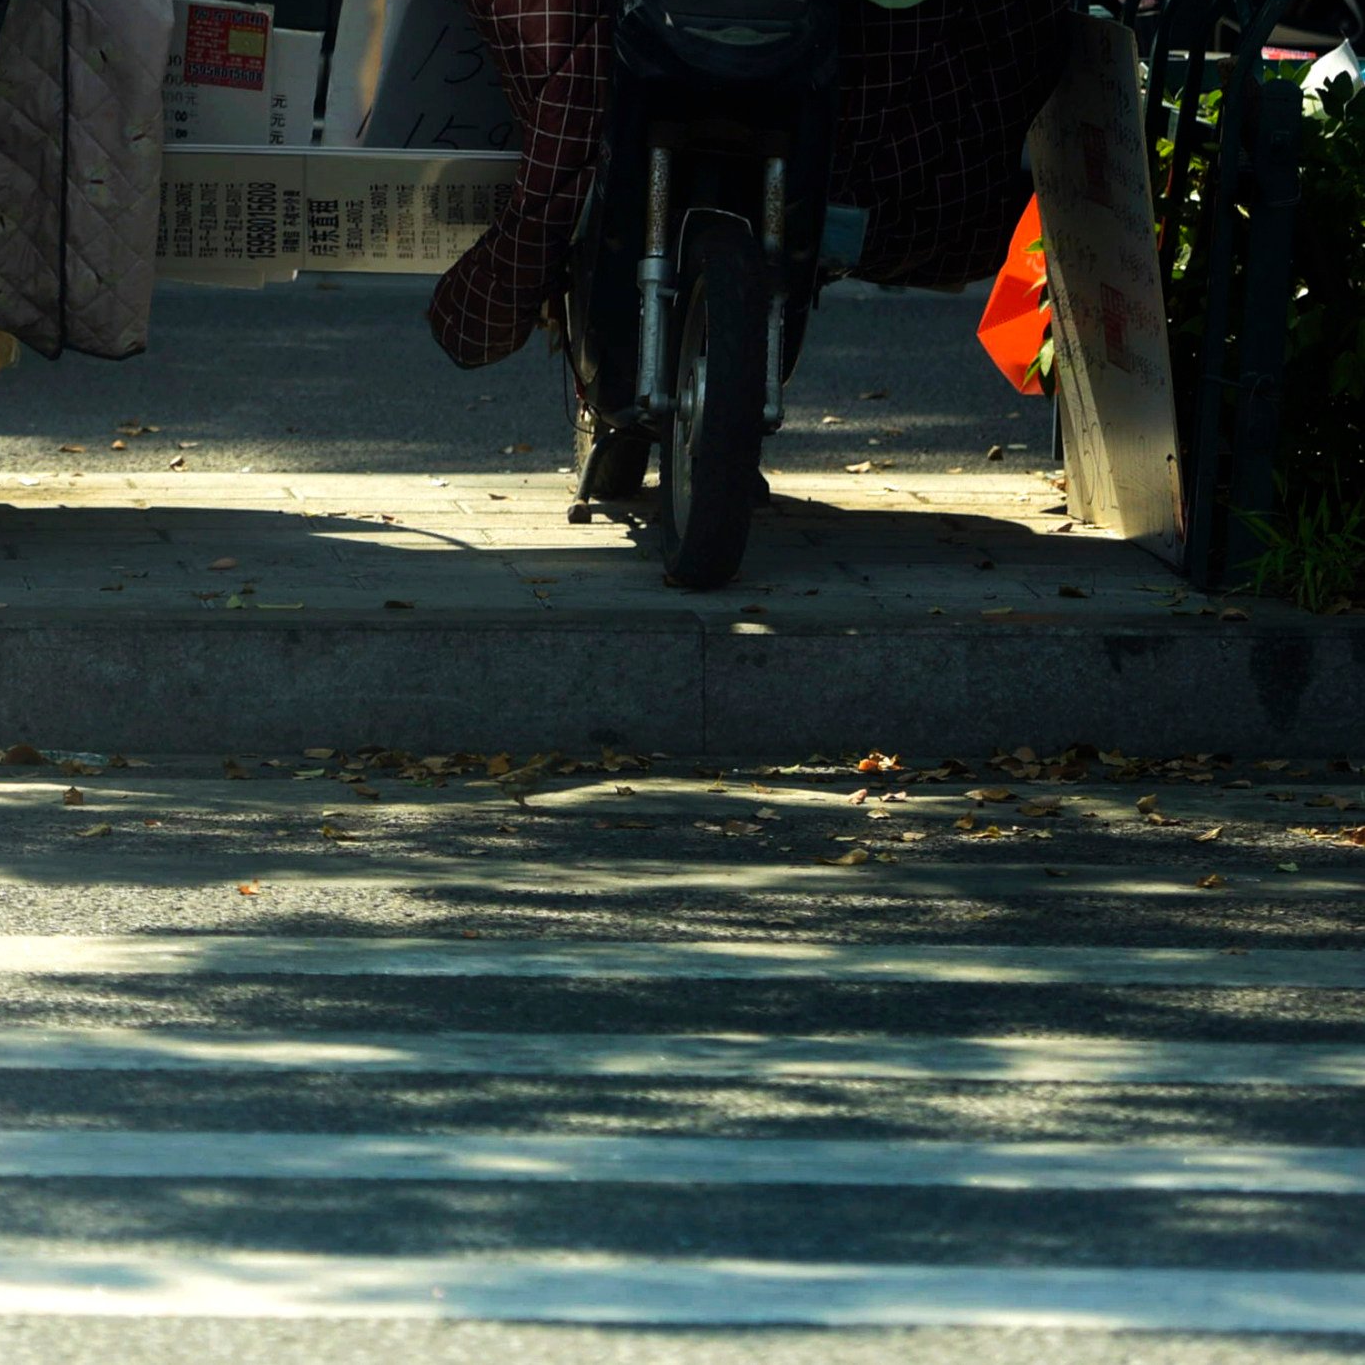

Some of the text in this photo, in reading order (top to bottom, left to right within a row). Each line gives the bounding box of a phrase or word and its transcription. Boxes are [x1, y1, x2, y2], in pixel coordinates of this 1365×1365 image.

[247, 182, 276, 260] 15958015608
[307, 199, 339, 258] 房东直租
